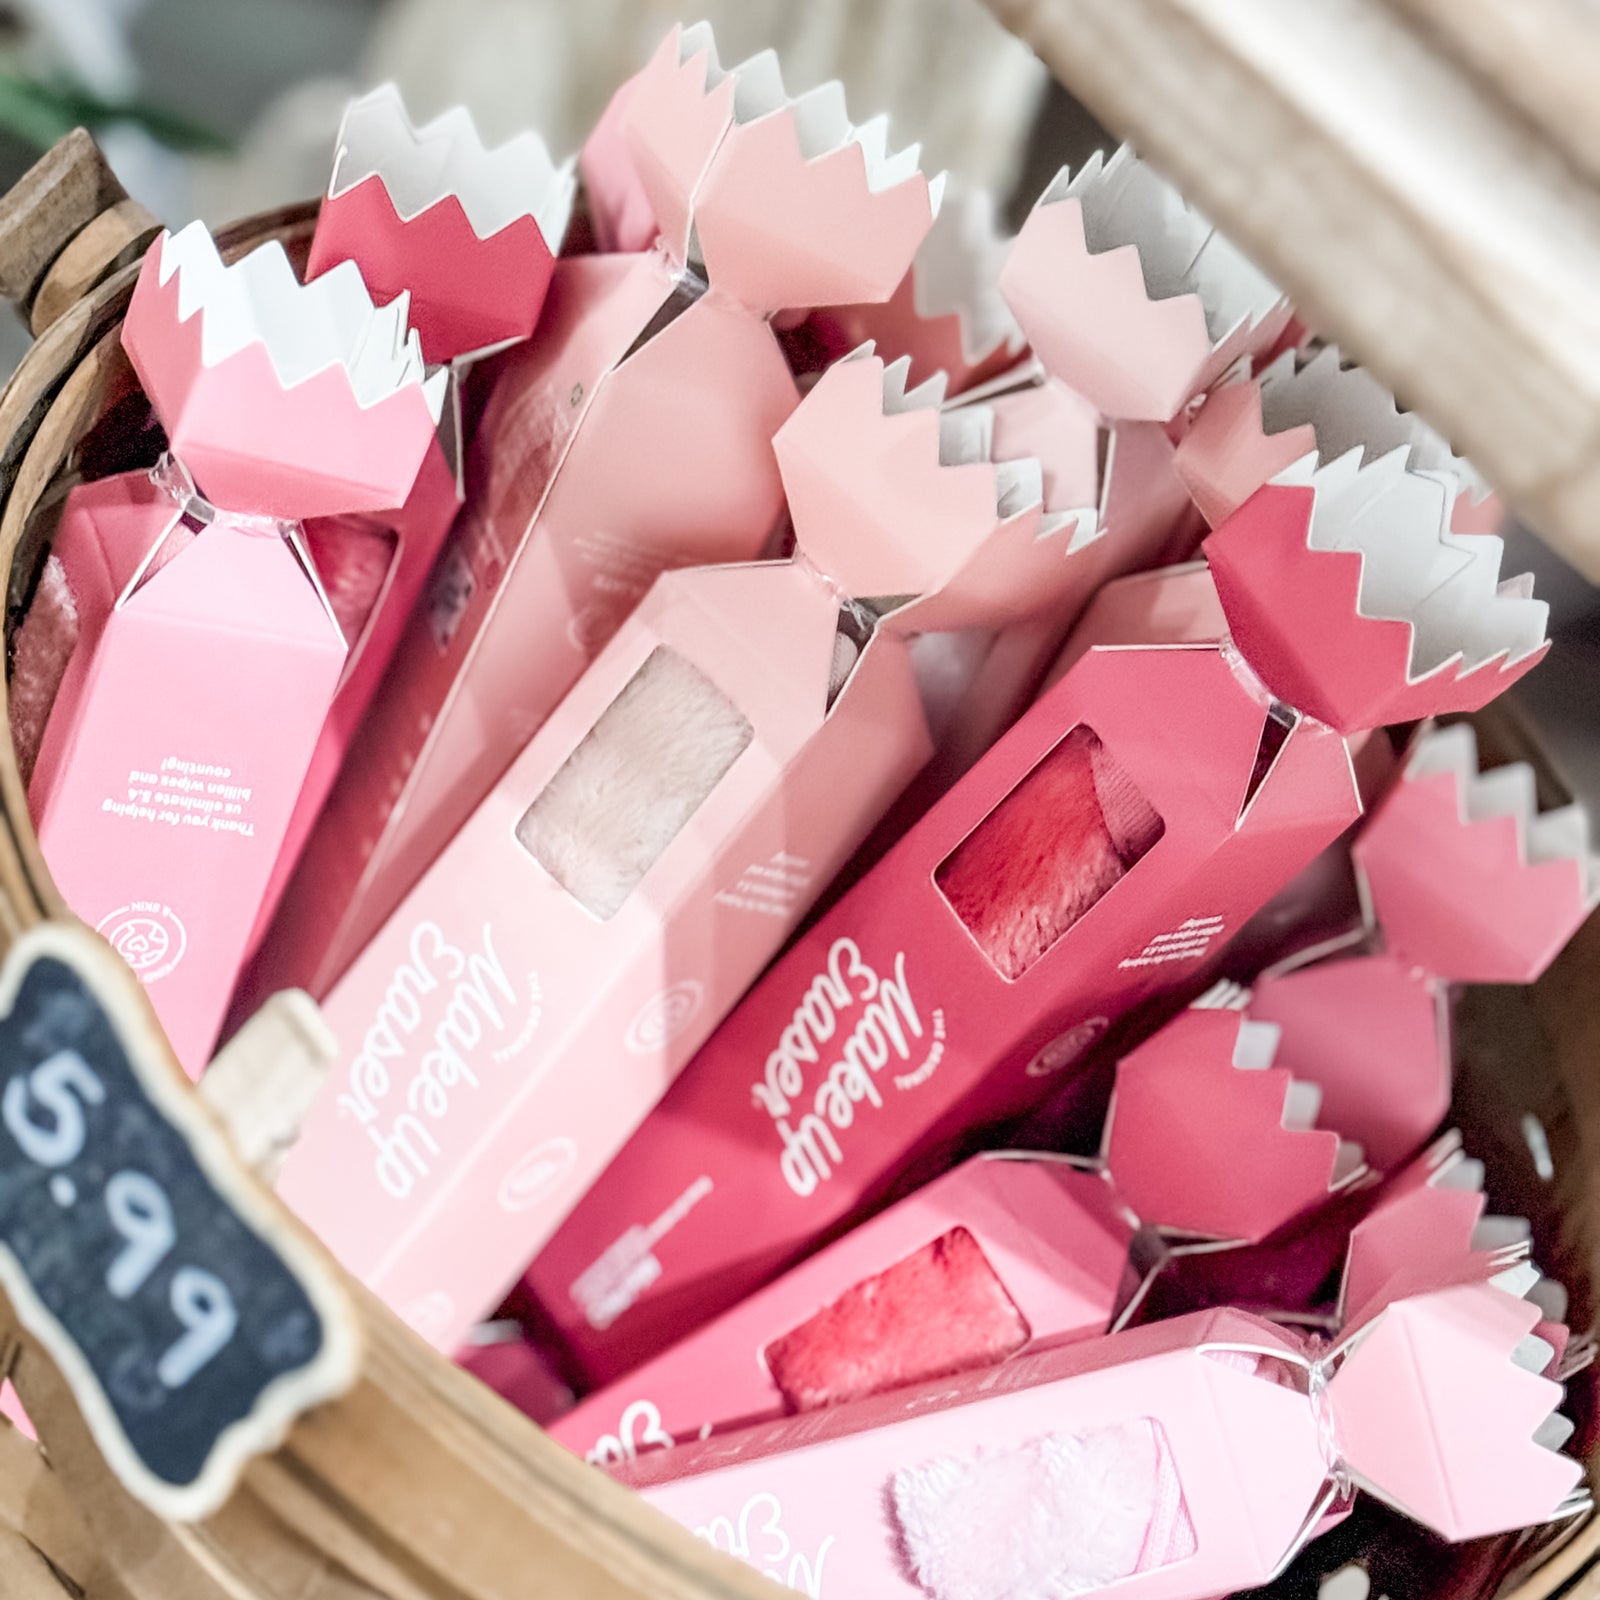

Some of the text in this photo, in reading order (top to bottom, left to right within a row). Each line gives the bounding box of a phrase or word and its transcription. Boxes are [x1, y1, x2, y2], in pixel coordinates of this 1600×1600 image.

[161, 756, 231, 778] counting!
[128, 770, 252, 802] billion wipes and
[102, 798, 255, 836] Thank you for helping
[154, 792, 223, 813] eliminate
[224, 802, 242, 814] us
[131, 900, 161, 914] SKIN
[337, 920, 466, 1124] Eraser
[752, 936, 879, 1118] Eraser
[2, 1048, 238, 1389] 5.99
